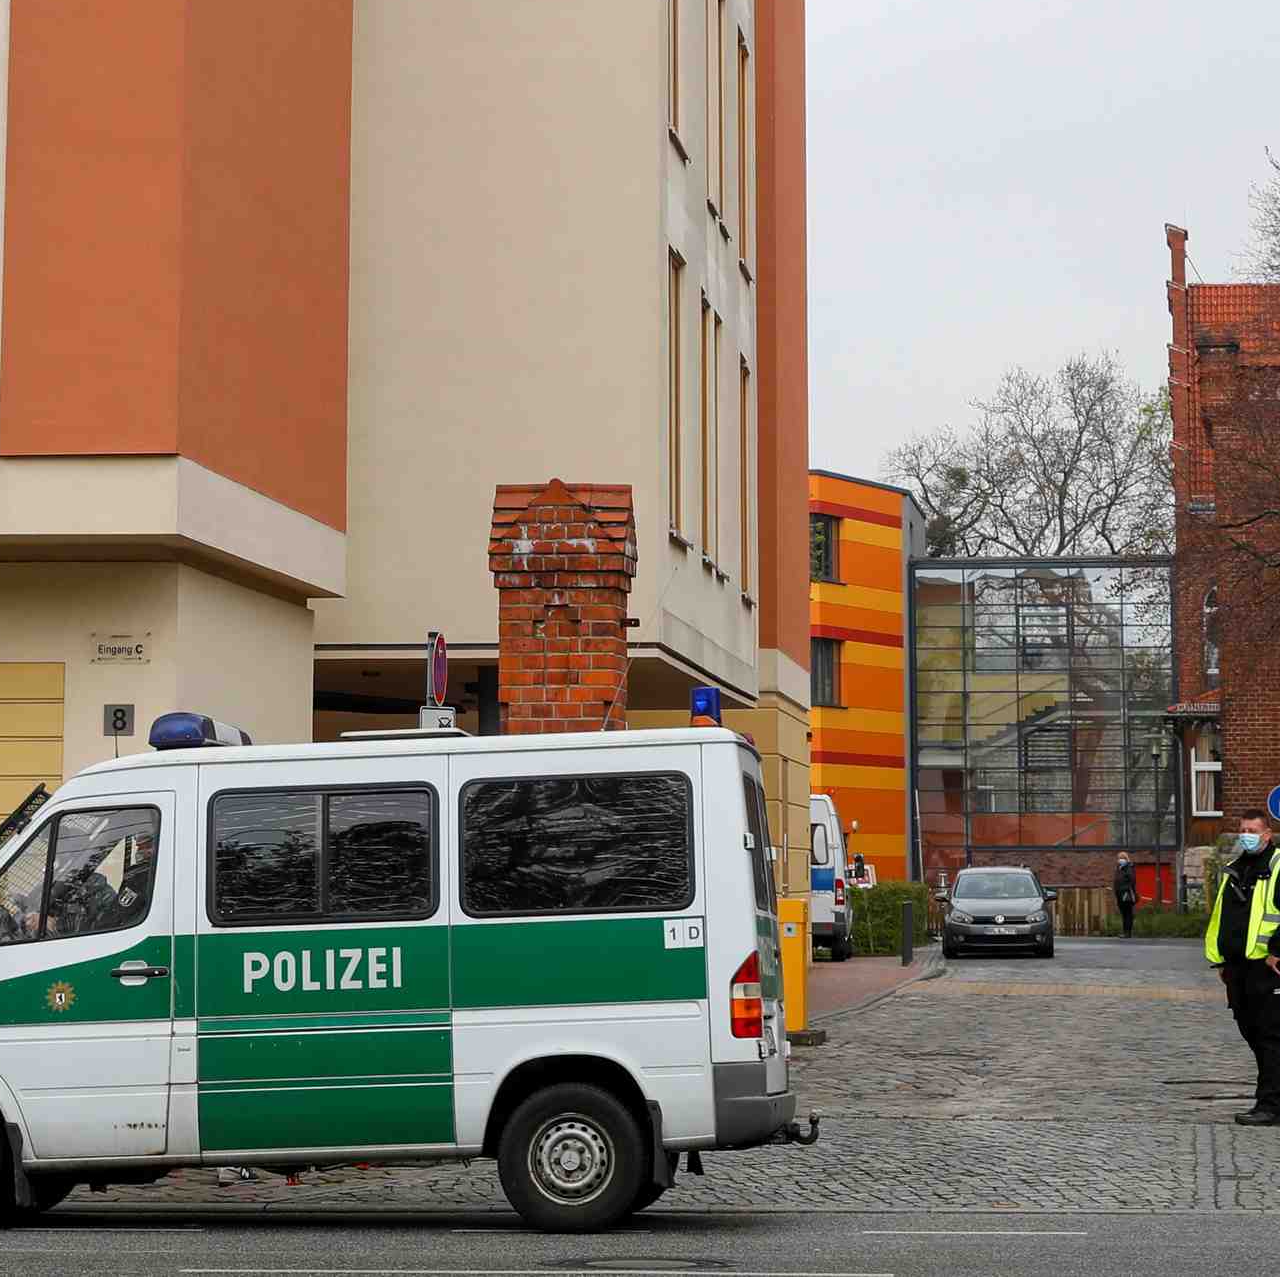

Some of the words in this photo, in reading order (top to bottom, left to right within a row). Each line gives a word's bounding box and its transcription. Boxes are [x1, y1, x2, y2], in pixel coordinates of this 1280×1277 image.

[97, 643, 133, 656] Eingang
[135, 644, 144, 655] C
[112, 708, 127, 731] 8
[689, 925, 700, 940] D
[243, 946, 402, 994] POLIZEI
